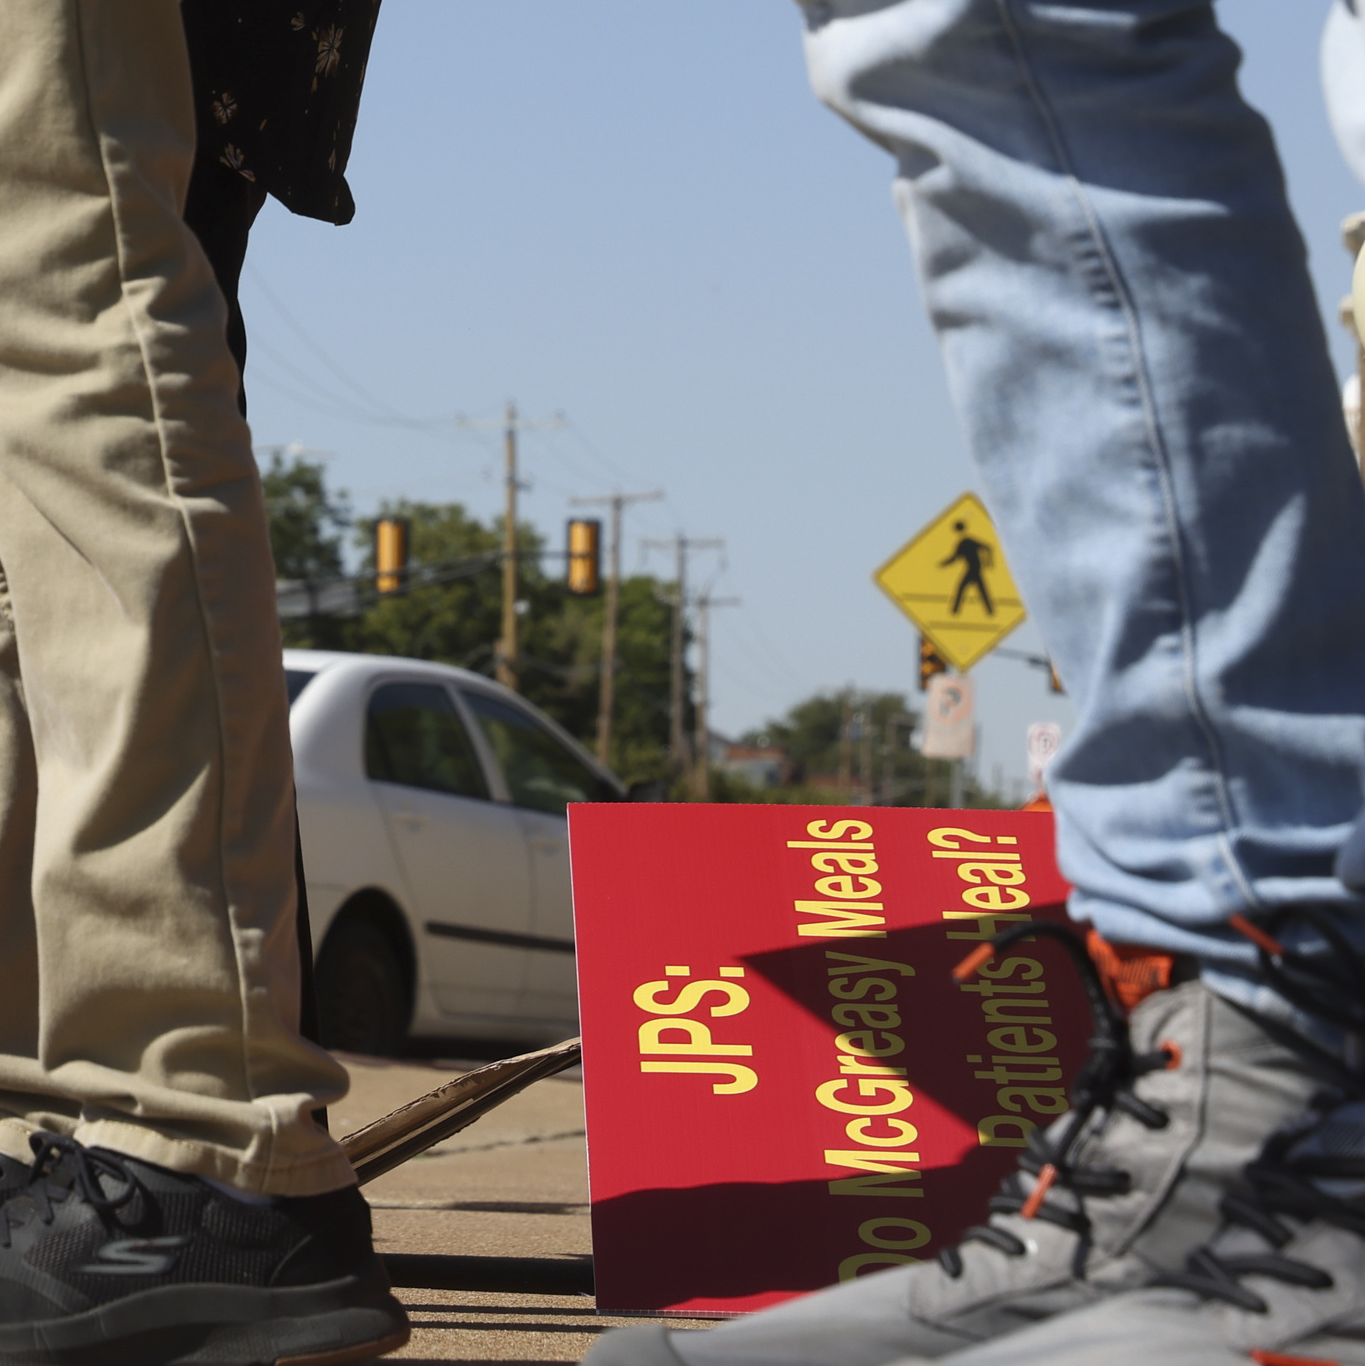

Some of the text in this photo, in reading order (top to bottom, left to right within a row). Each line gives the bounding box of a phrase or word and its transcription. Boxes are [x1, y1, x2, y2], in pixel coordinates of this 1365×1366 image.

[787, 820, 887, 938] Meals
[927, 827, 1037, 942] Heal?
[633, 966, 758, 1094] JPS:
[815, 952, 924, 1197] McGreasy
